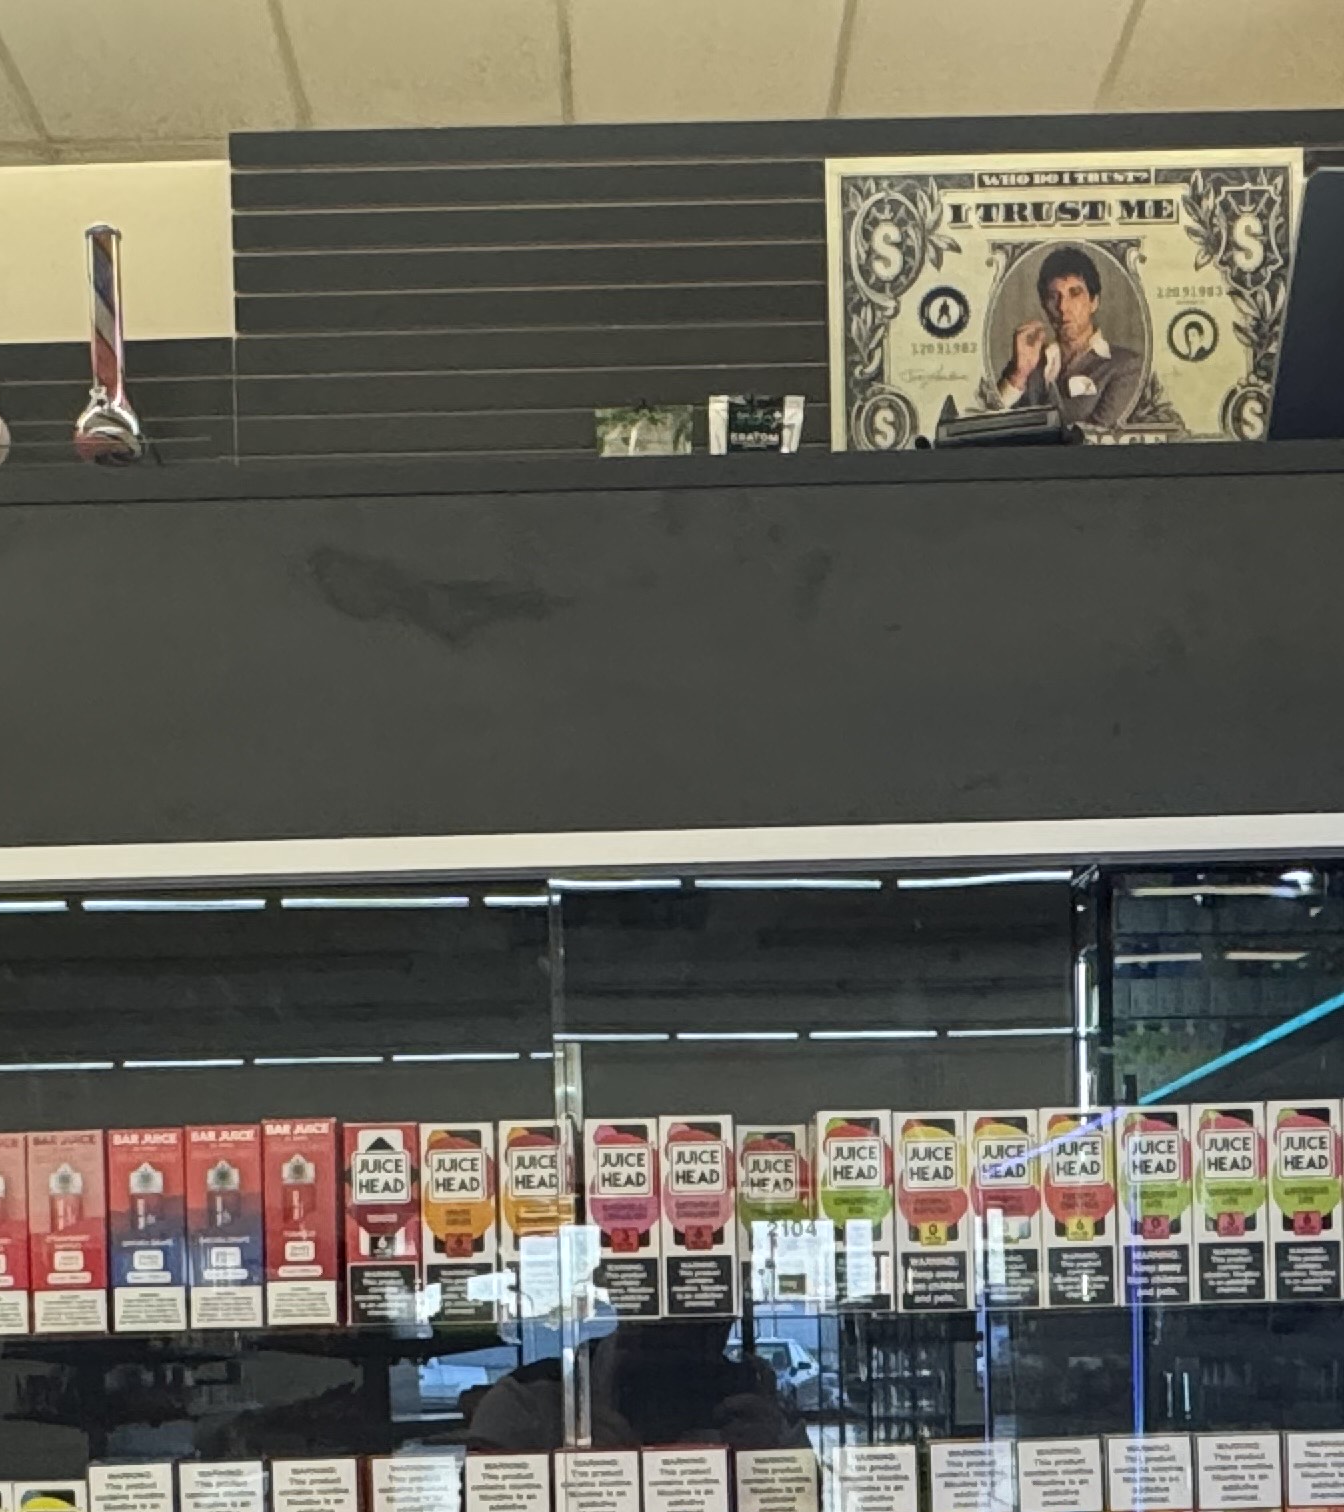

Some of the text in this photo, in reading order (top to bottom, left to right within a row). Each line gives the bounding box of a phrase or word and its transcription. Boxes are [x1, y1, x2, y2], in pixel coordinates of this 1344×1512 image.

[982, 174, 1030, 186] WHO
[1062, 173, 1071, 183] I
[1074, 172, 1149, 183] TRUST?
[948, 199, 1179, 227] I TRUST ME
[112, 1132, 178, 1146] BAR JUICE
[190, 1129, 255, 1143] BAR JUICE
[1282, 1135, 1329, 1153] JUICE
[831, 1146, 877, 1164] JUICE
[1204, 1137, 1251, 1155] JUICE
[431, 1157, 480, 1173] JUICE
[600, 1153, 646, 1169] JUICE
[674, 1148, 720, 1165] JUICE
[1207, 1155, 1252, 1173] HEAD
[1284, 1154, 1329, 1171] HEAD
[358, 1158, 404, 1176] JUICE
[832, 1164, 878, 1181] HEAD
[358, 1177, 405, 1195] HEAD
[434, 1174, 481, 1193] HEAD
[601, 1171, 647, 1189] HEAD
[675, 1168, 720, 1186] HEAD
[766, 1220, 818, 1238] 2104
